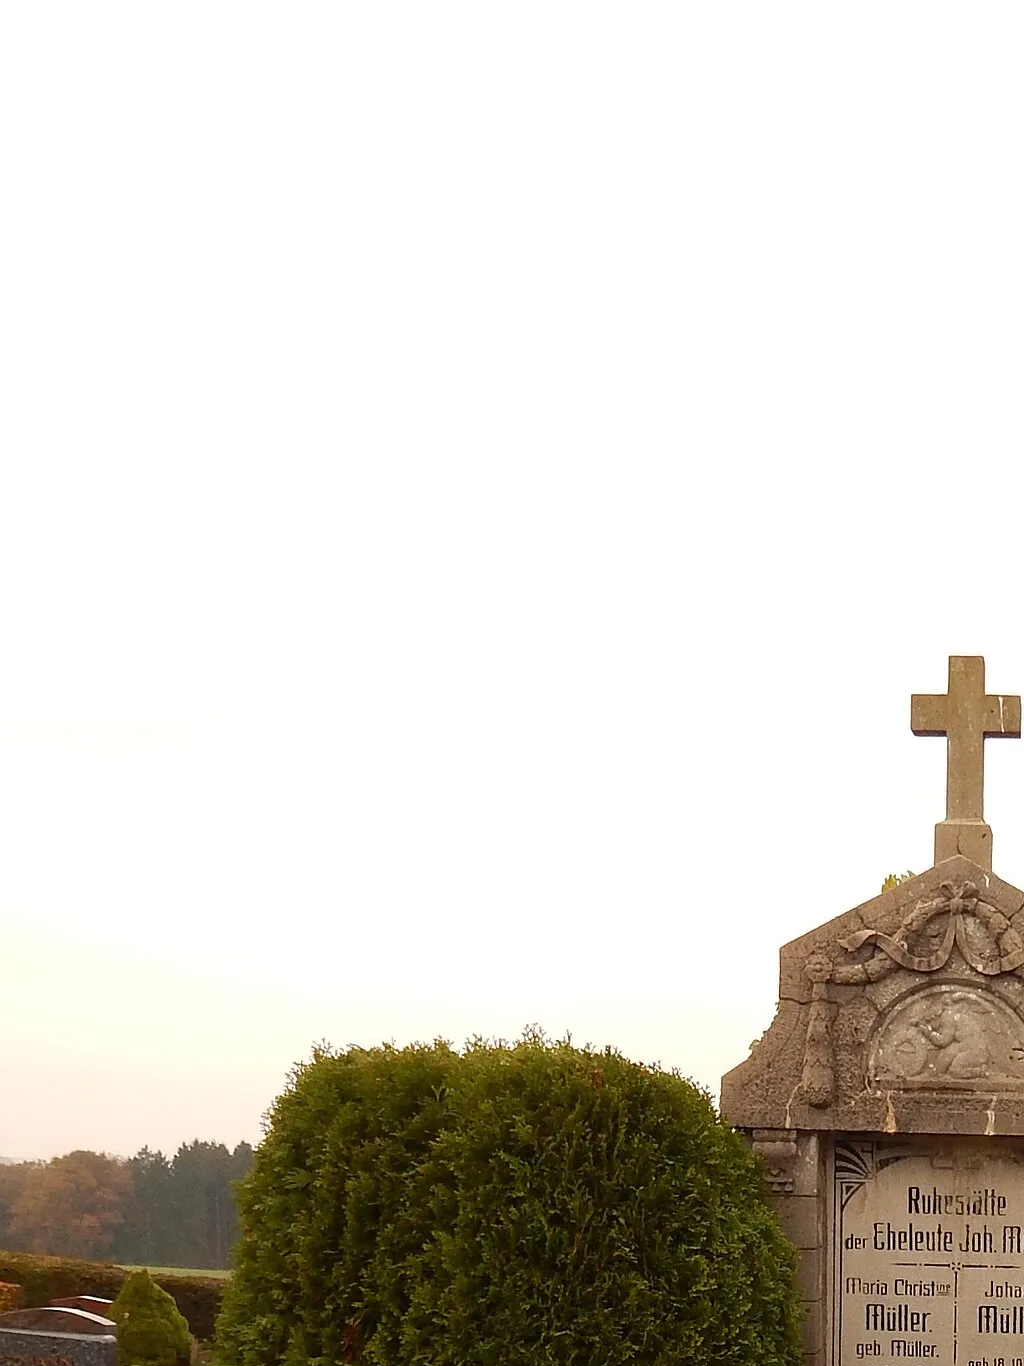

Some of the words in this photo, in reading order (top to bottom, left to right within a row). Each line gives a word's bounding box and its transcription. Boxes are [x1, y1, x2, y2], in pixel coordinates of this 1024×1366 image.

[845, 1233, 868, 1249] der
[874, 1223, 953, 1252] Eheleute
[959, 1225, 997, 1252] Joh.
[846, 1278, 887, 1295] Maria
[891, 1340, 939, 1358] Müller.
